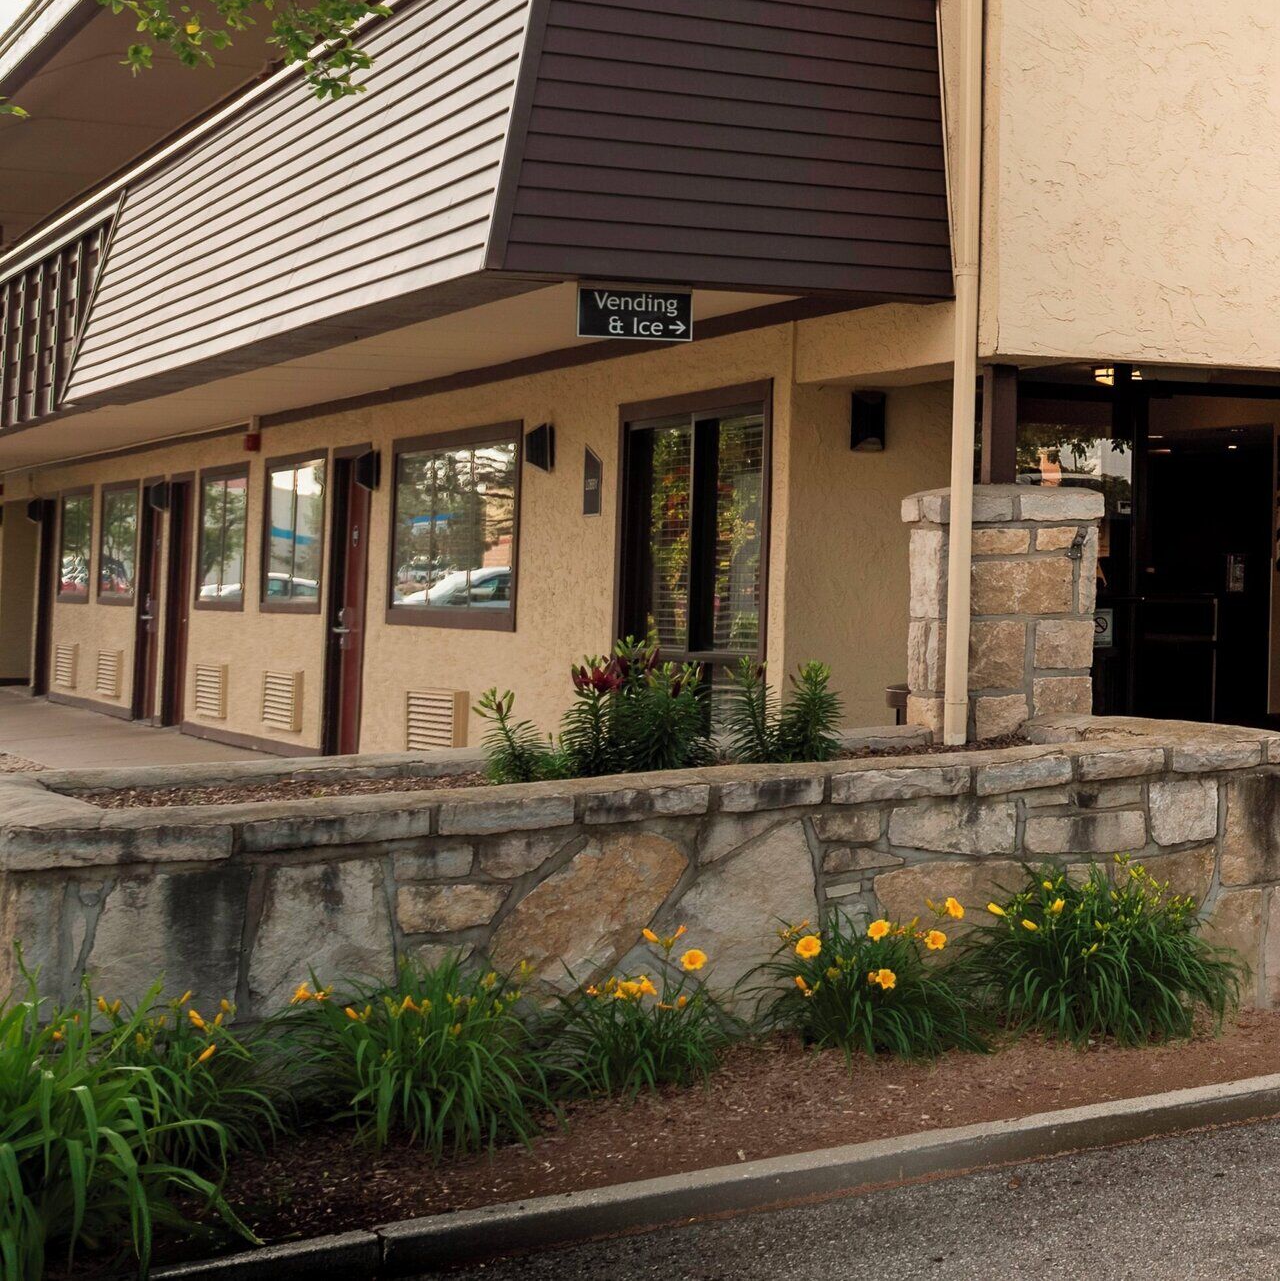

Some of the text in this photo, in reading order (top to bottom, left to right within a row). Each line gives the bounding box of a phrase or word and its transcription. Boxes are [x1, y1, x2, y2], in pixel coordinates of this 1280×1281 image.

[594, 291, 678, 317] Vending
[608, 316, 664, 336] & Ice
